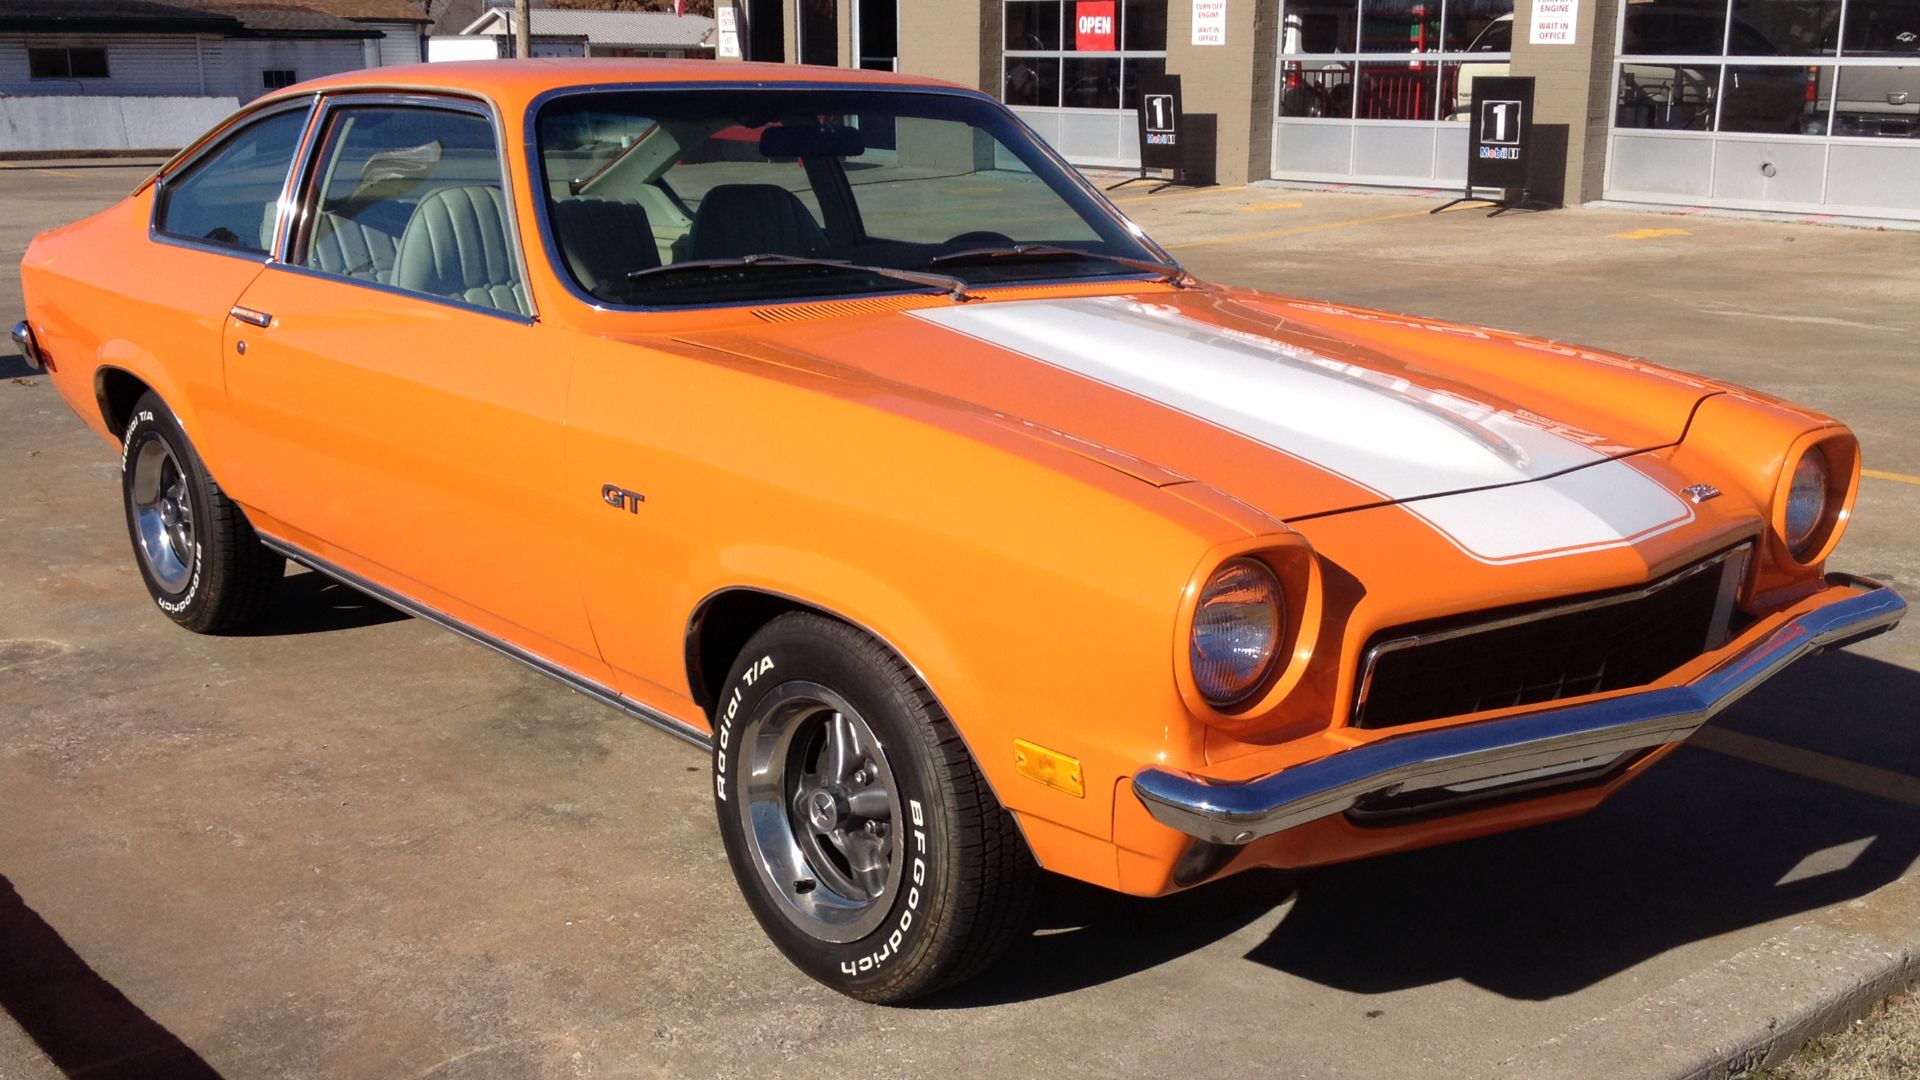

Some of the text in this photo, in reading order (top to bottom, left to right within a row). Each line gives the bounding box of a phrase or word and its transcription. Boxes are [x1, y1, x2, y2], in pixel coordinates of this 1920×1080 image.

[1079, 16, 1111, 34] OPEN
[1153, 98, 1164, 129] 1
[1493, 104, 1506, 141] 1
[1480, 146, 1508, 159] Mobil
[121, 410, 154, 472] Radial T/A
[601, 483, 645, 514] GT
[158, 542, 201, 612] BFGoodrich
[714, 655, 775, 801] Radial T/A
[840, 799, 926, 977] BFGoodrich
